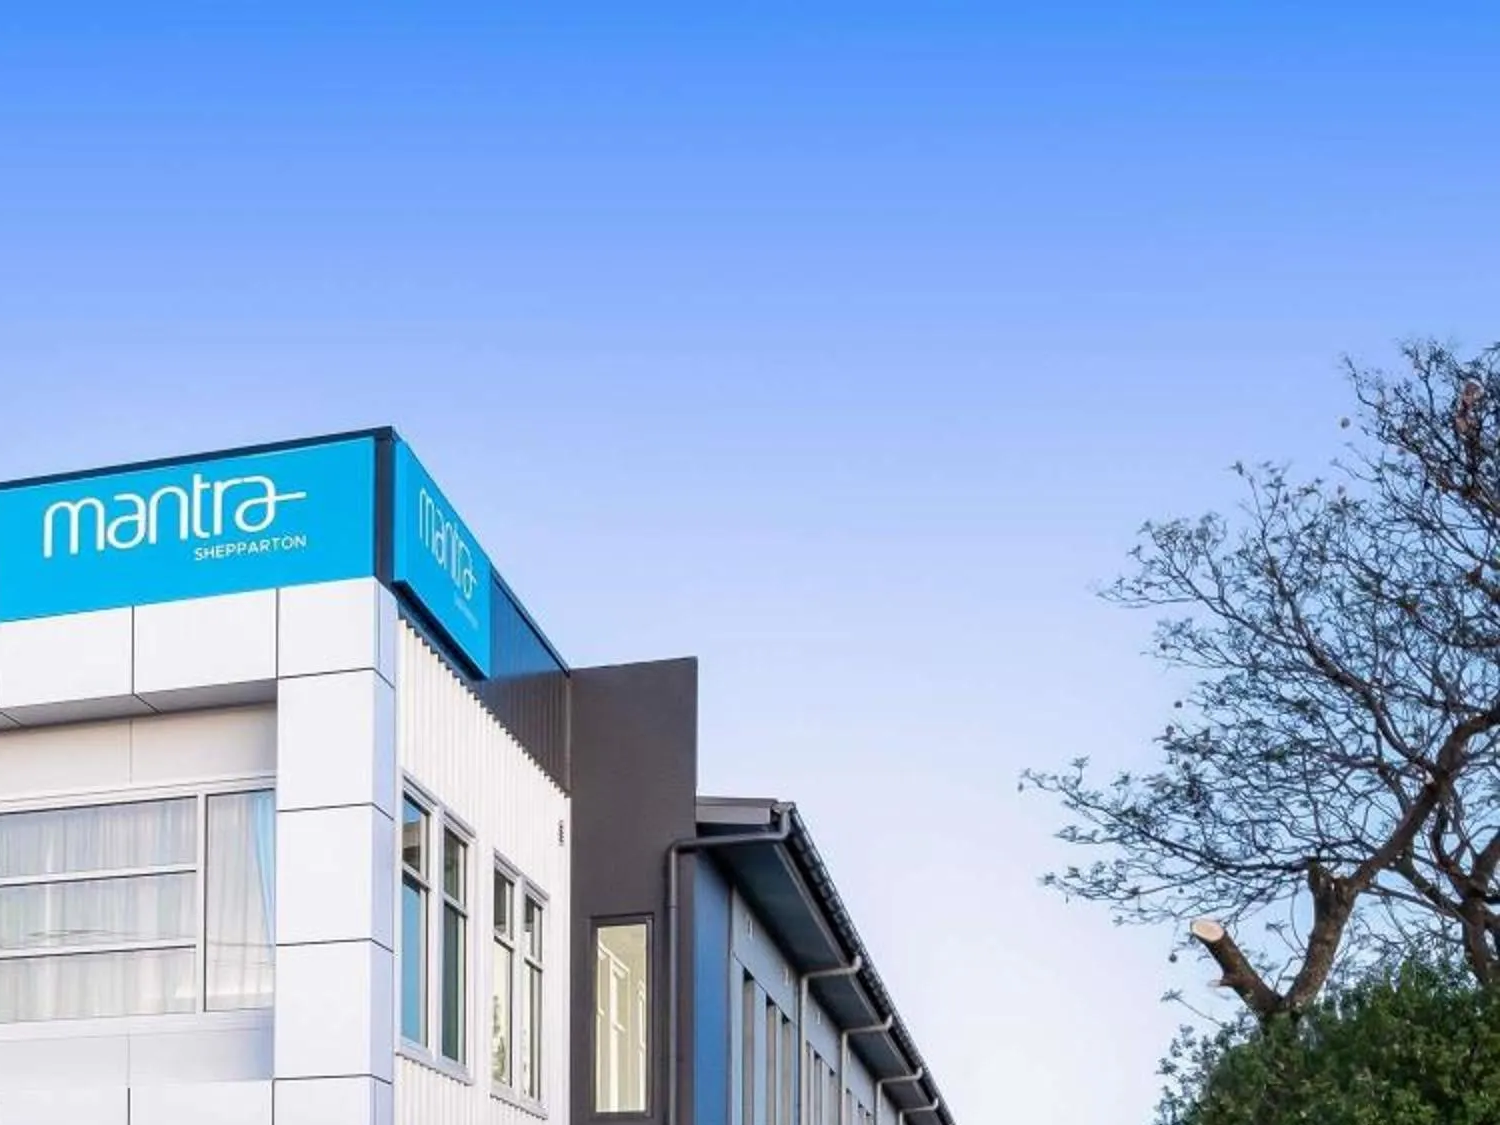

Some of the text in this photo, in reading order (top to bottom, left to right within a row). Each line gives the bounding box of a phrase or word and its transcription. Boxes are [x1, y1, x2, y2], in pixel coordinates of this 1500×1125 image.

[44, 474, 306, 558] mantra
[195, 535, 307, 561] SHEPPARTON
[419, 487, 478, 600] mantra
